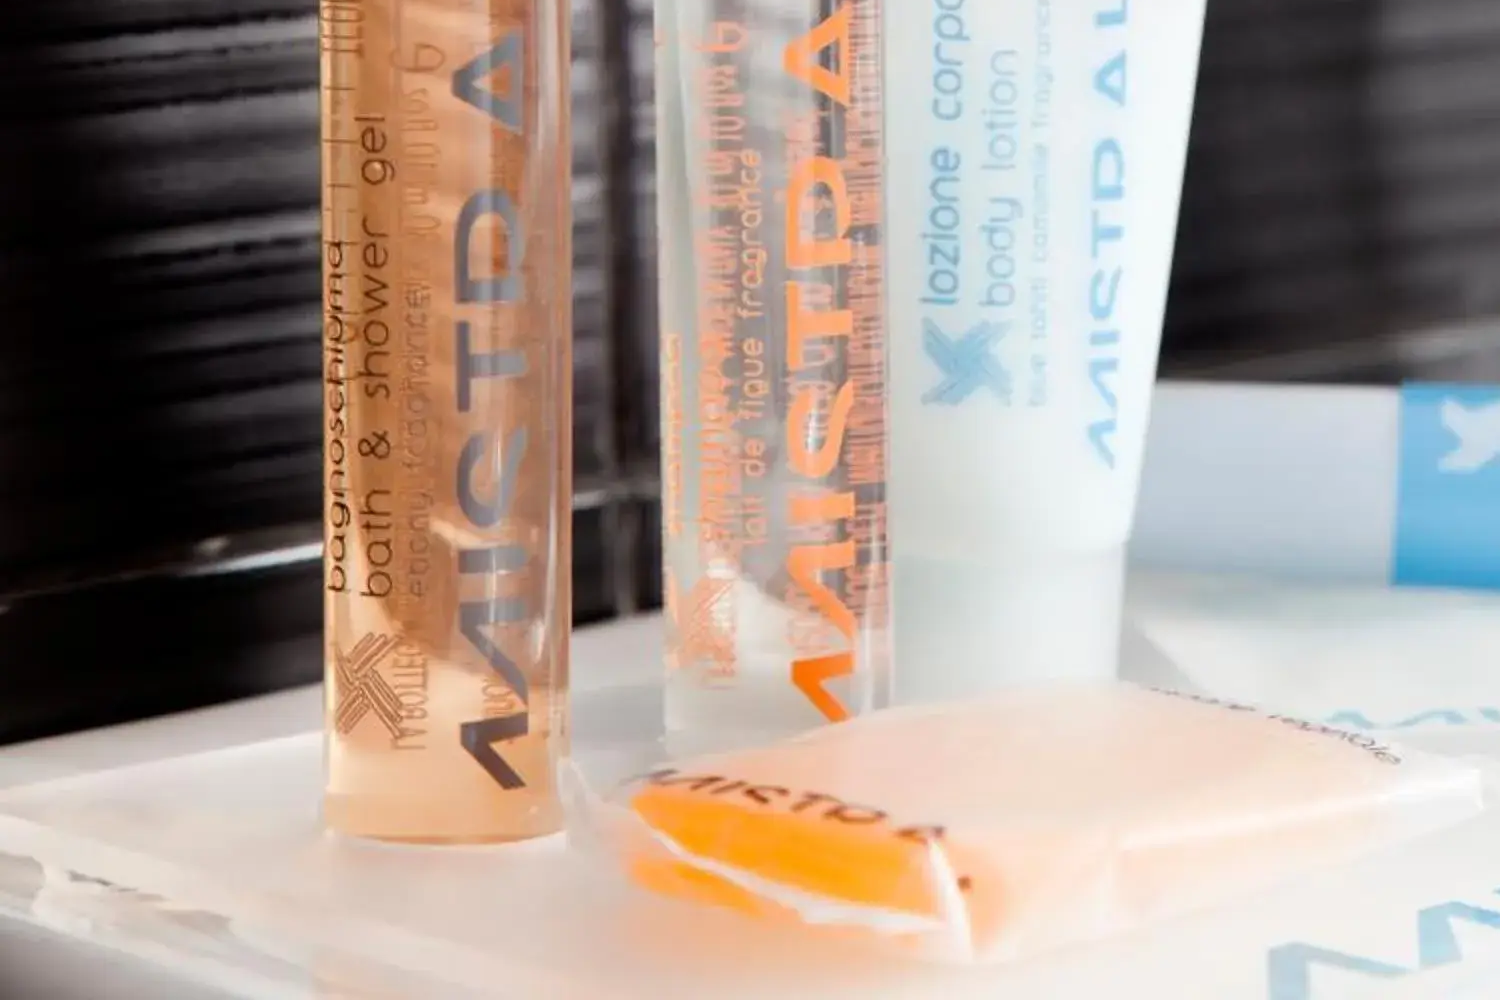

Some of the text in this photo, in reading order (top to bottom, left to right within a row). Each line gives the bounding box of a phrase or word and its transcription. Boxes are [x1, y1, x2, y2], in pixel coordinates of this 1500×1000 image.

[736, 148, 768, 319] fragrance
[919, 146, 962, 306] lozione
[977, 49, 1022, 307] body lotion
[1028, 142, 1052, 263] camomile
[354, 114, 394, 598] bath & shower gel
[1026, 353, 1049, 407] blue
[738, 438, 767, 477] de
